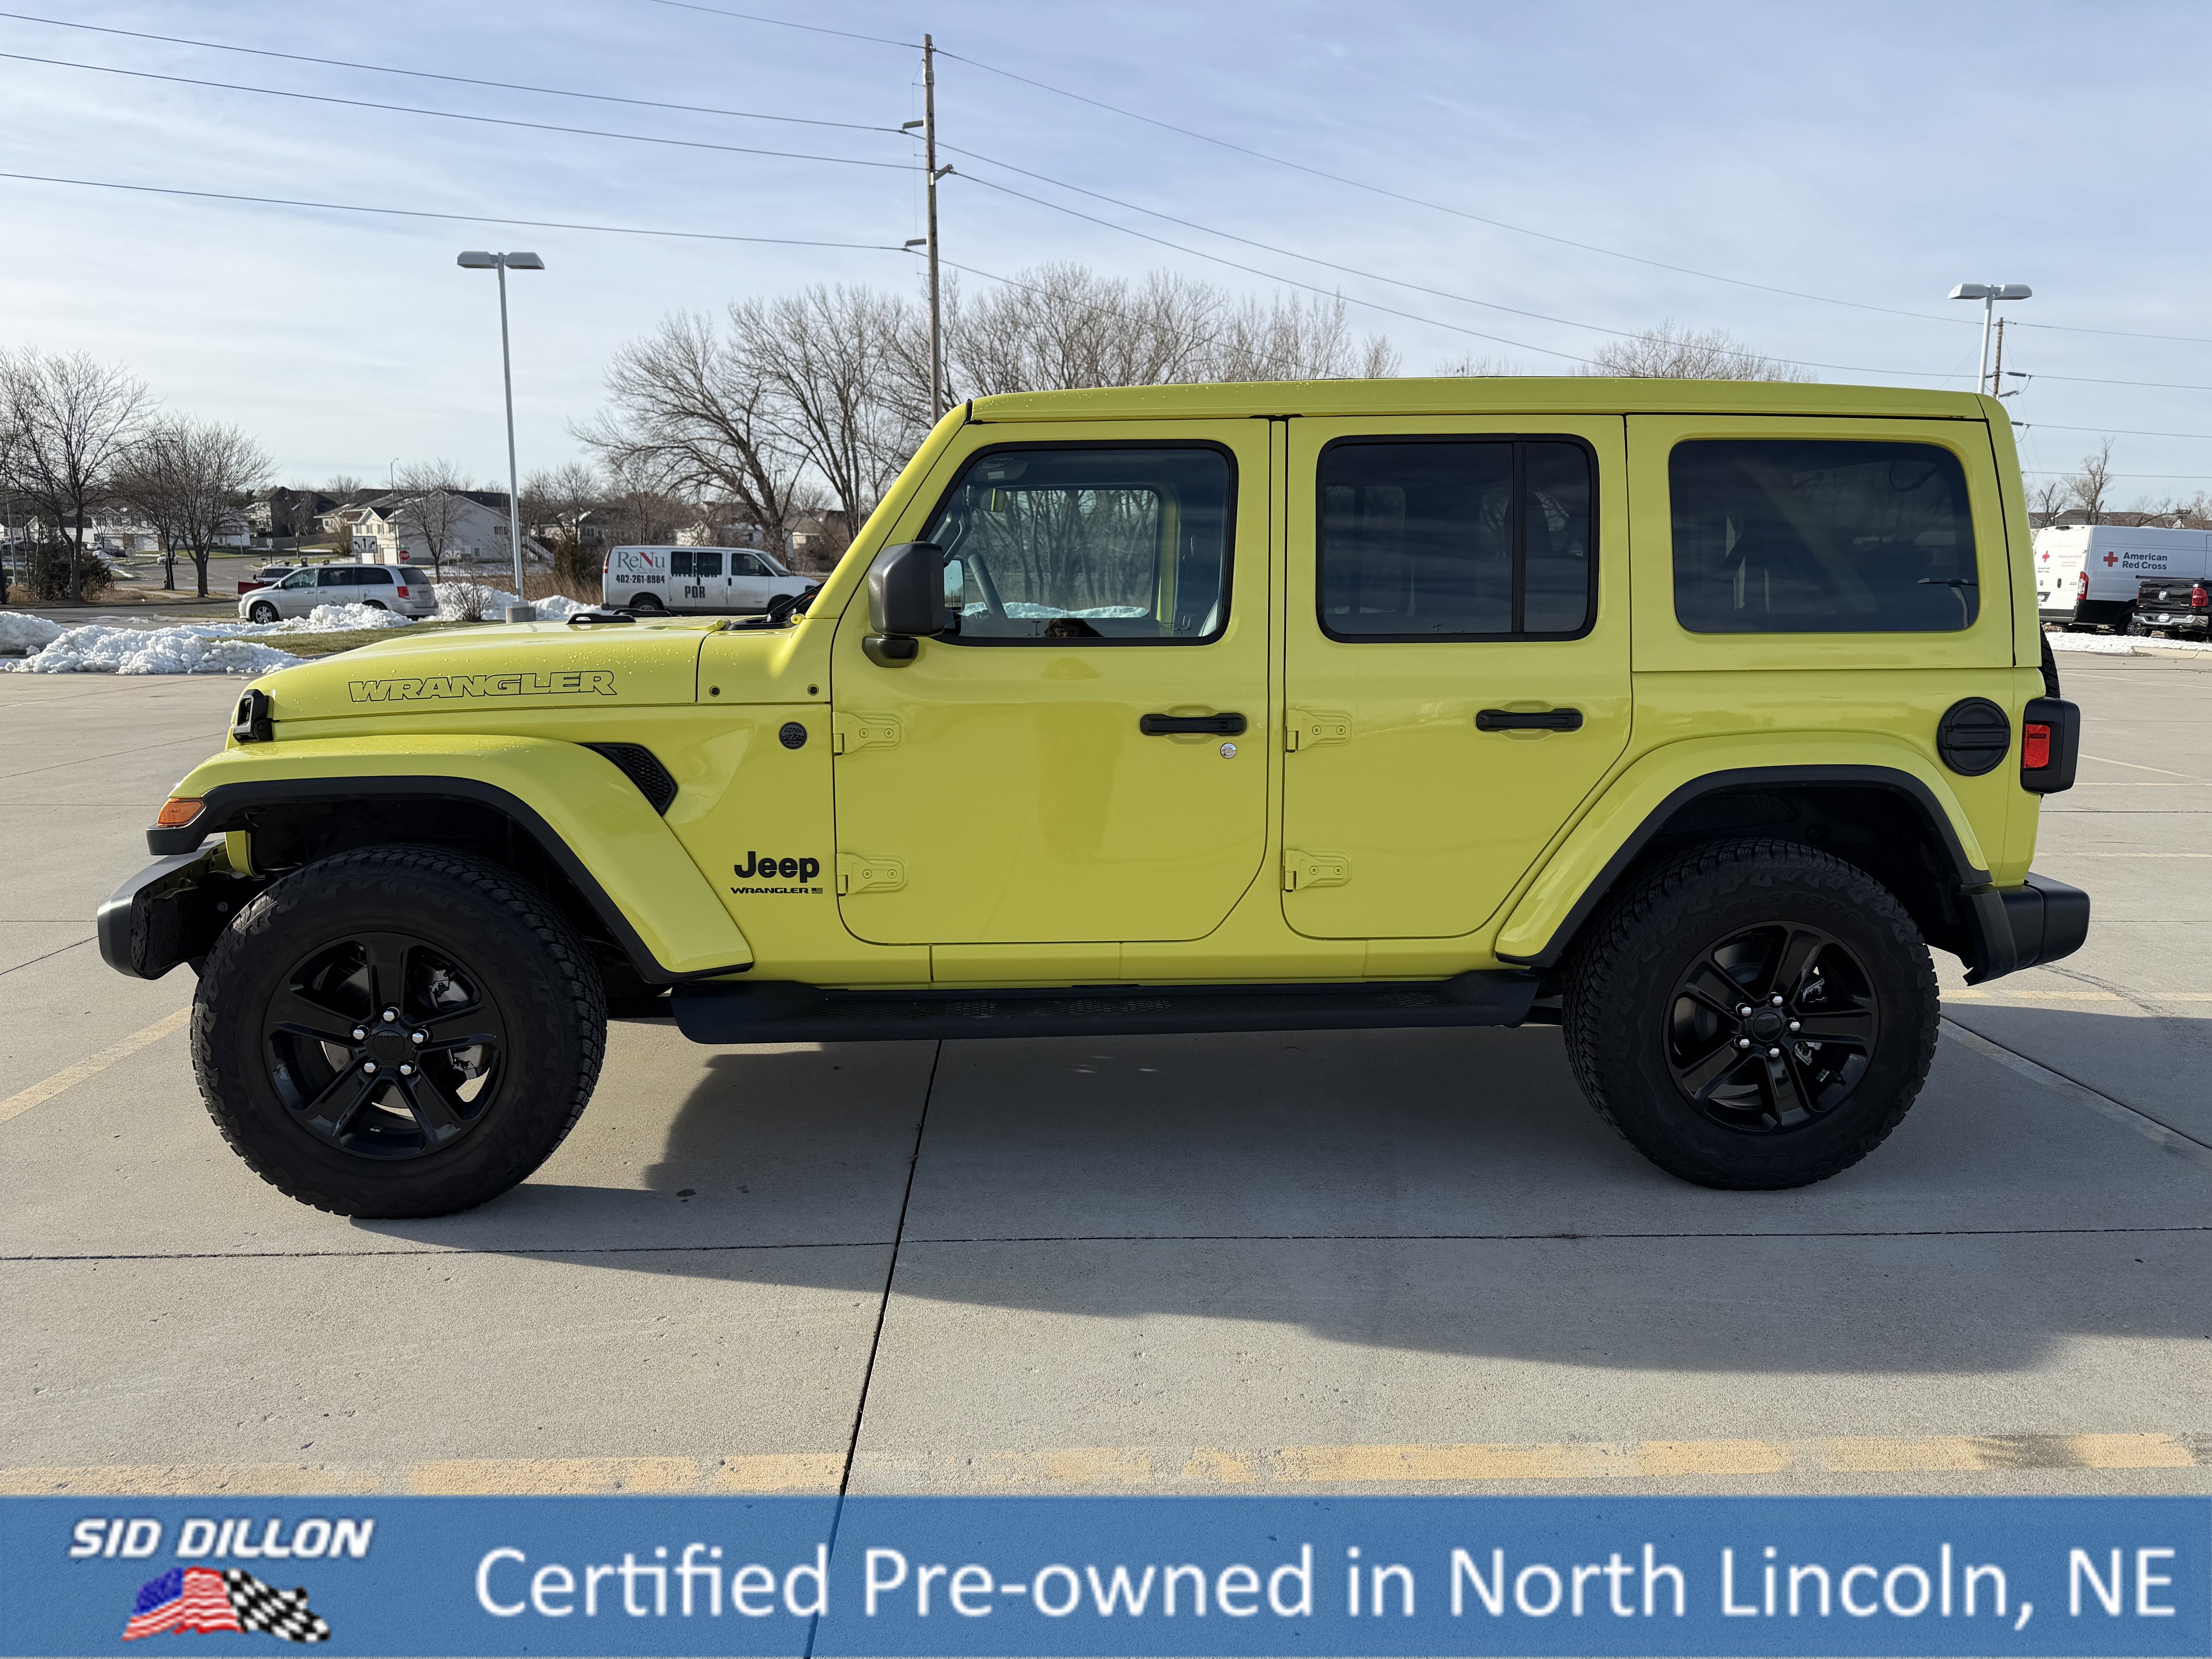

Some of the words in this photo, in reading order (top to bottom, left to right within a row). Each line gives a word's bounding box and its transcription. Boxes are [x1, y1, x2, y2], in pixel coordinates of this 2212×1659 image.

[617, 551, 665, 572] ReNu
[2123, 552, 2167, 561] American
[2141, 562, 2167, 570] Cross
[616, 575, 665, 584] 402-261-8984
[685, 586, 705, 598] PDR
[349, 671, 617, 702] WRANGLER
[734, 851, 819, 883] Jeep
[1657, 890, 1866, 971] BRIDGESTONE
[466, 939, 541, 1159] BRIDGESTONE
